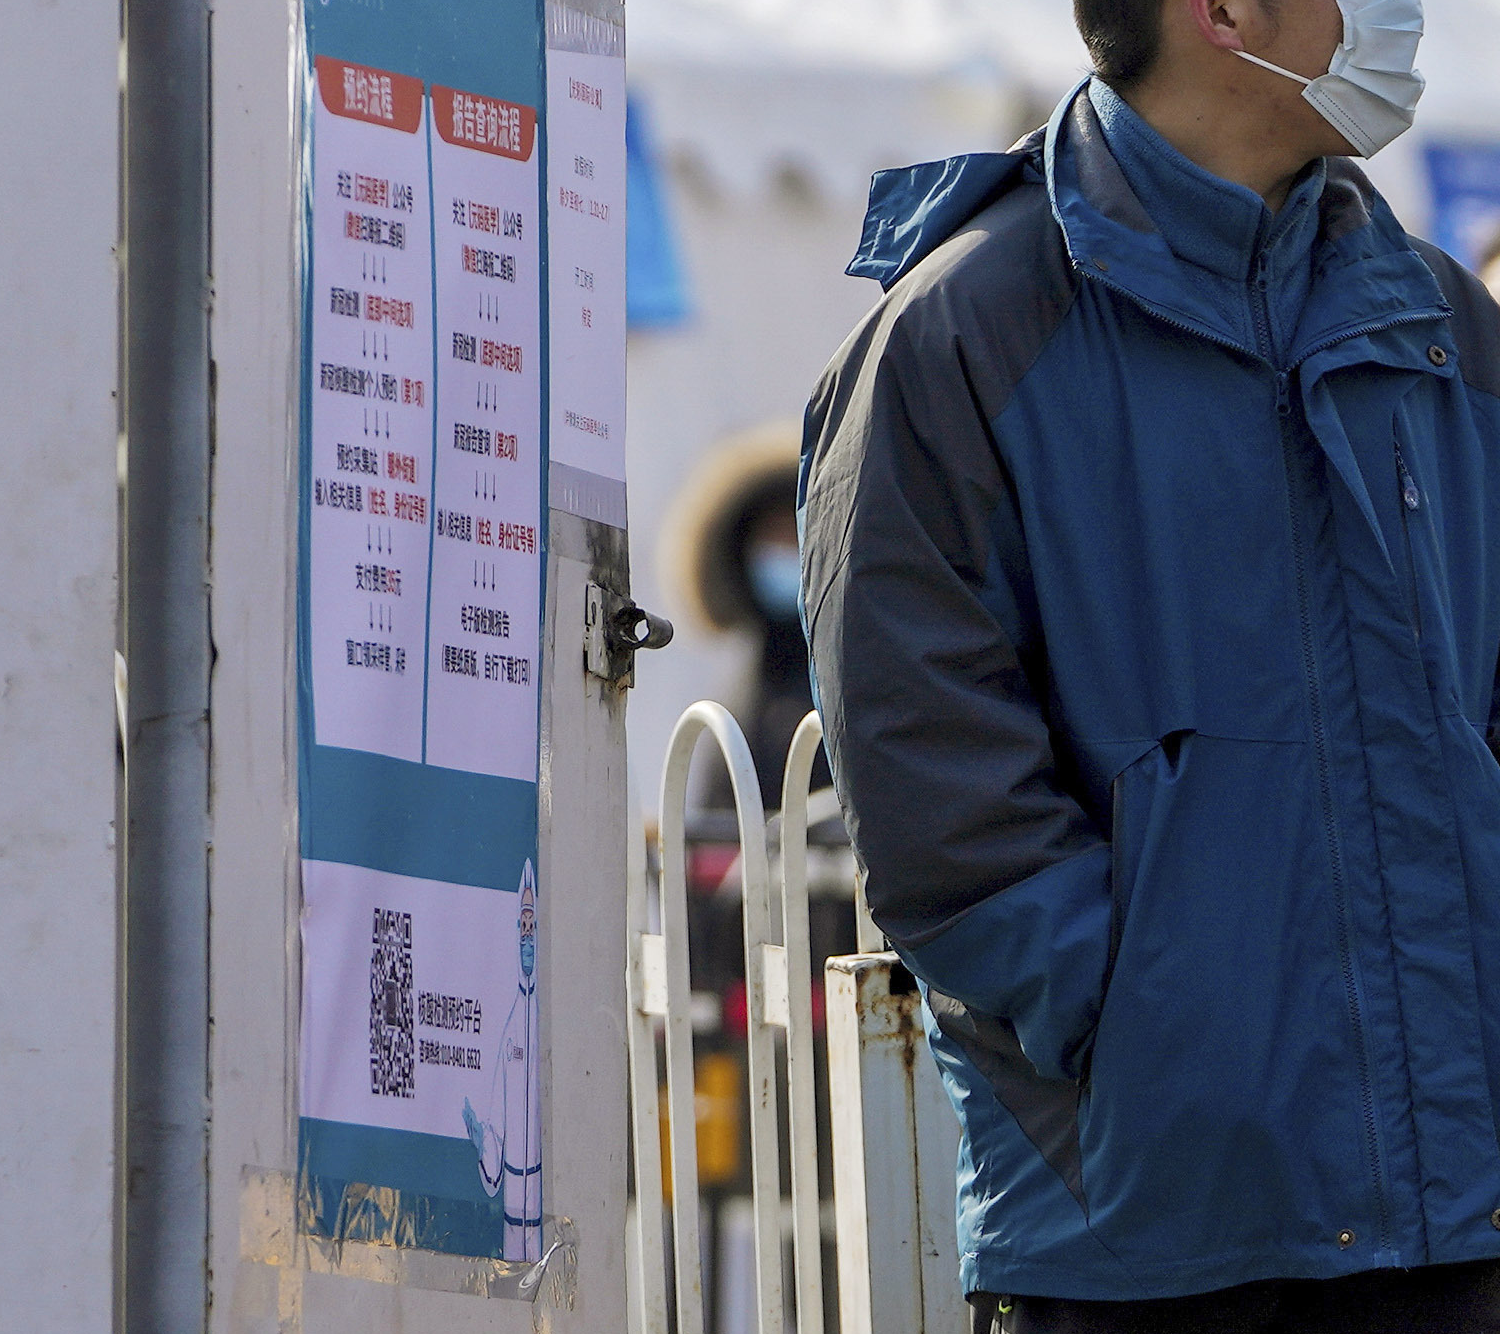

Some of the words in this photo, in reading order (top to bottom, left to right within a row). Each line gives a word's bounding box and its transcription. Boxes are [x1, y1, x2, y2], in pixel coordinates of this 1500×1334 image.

[343, 67, 394, 121] 预约流程
[452, 92, 521, 153] 报告查询流程
[418, 990, 482, 1035] 核酸检测预约平台
